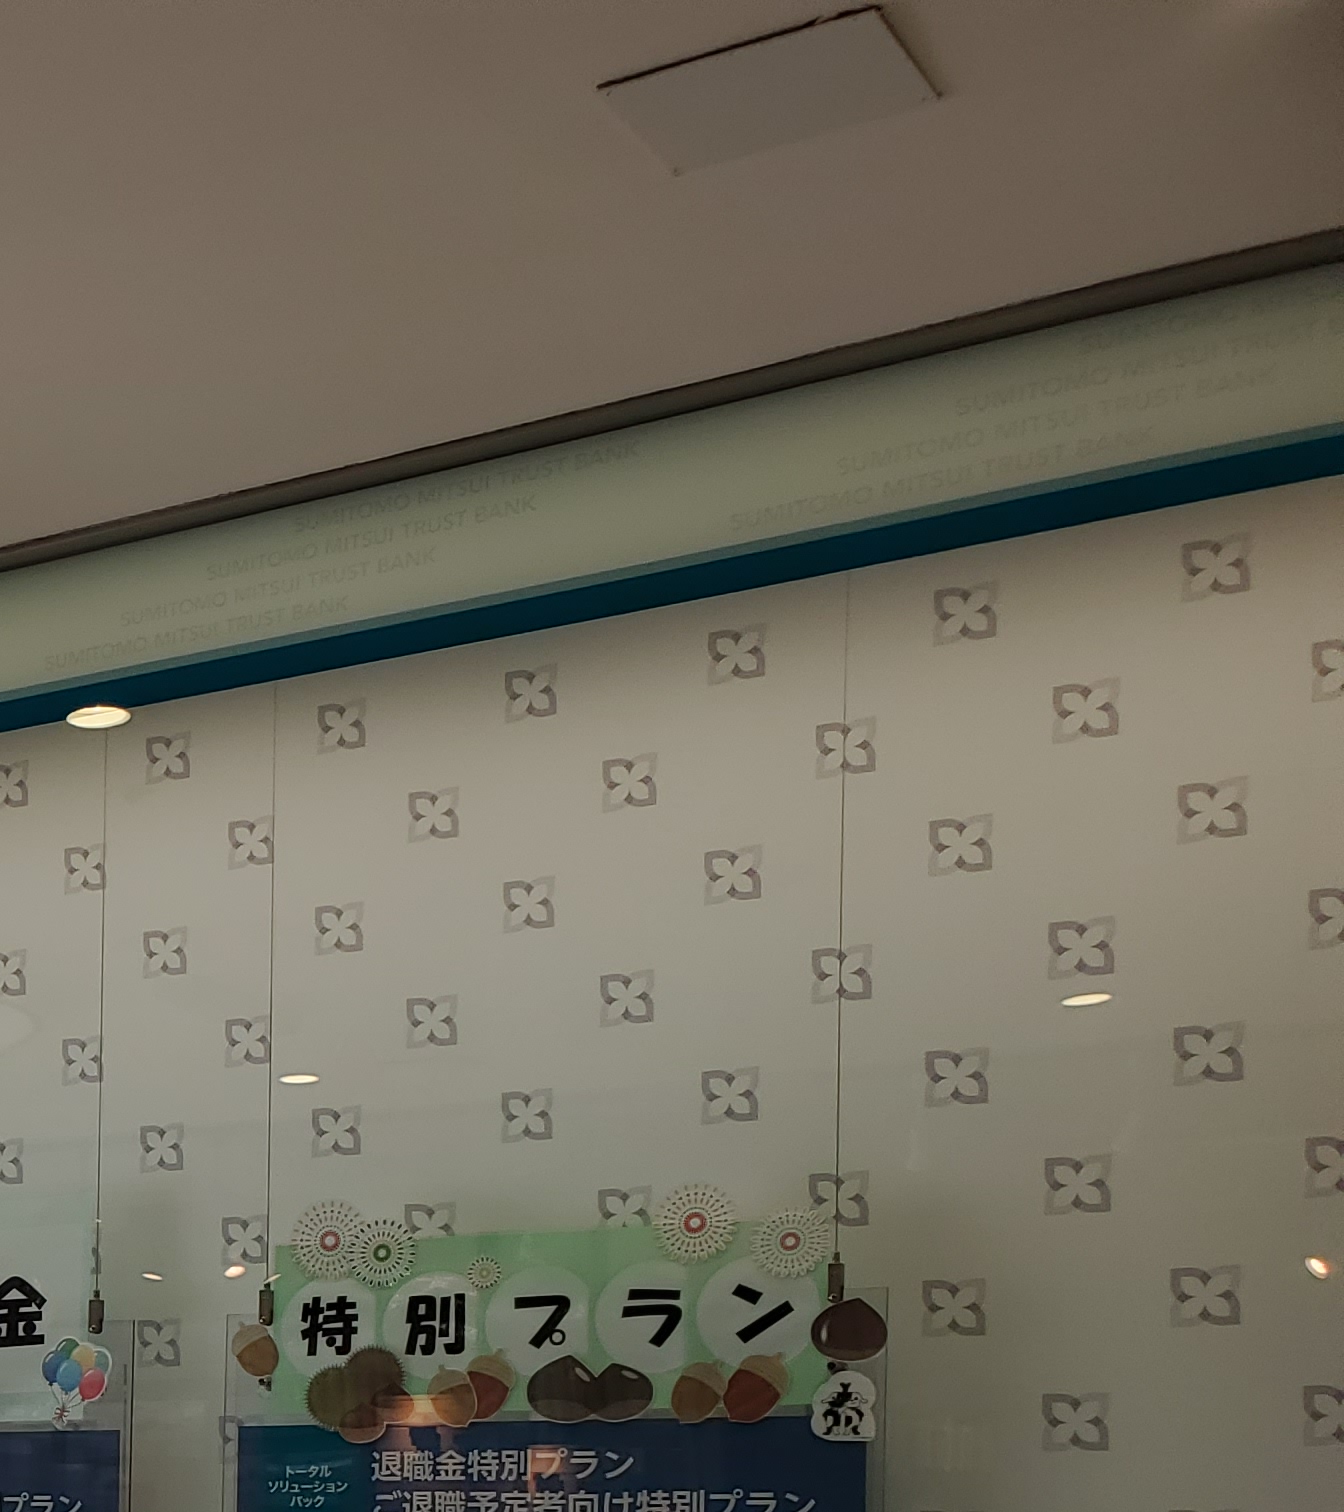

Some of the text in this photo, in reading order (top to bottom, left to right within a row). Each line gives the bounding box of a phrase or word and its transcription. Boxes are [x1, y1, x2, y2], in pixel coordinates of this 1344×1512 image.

[300, 1282, 795, 1358] 特別プラン
[283, 1464, 332, 1478] トータル
[371, 1448, 635, 1482] 退職金特別プラン
[267, 1479, 348, 1494] ソリューション
[289, 1494, 326, 1509] パック
